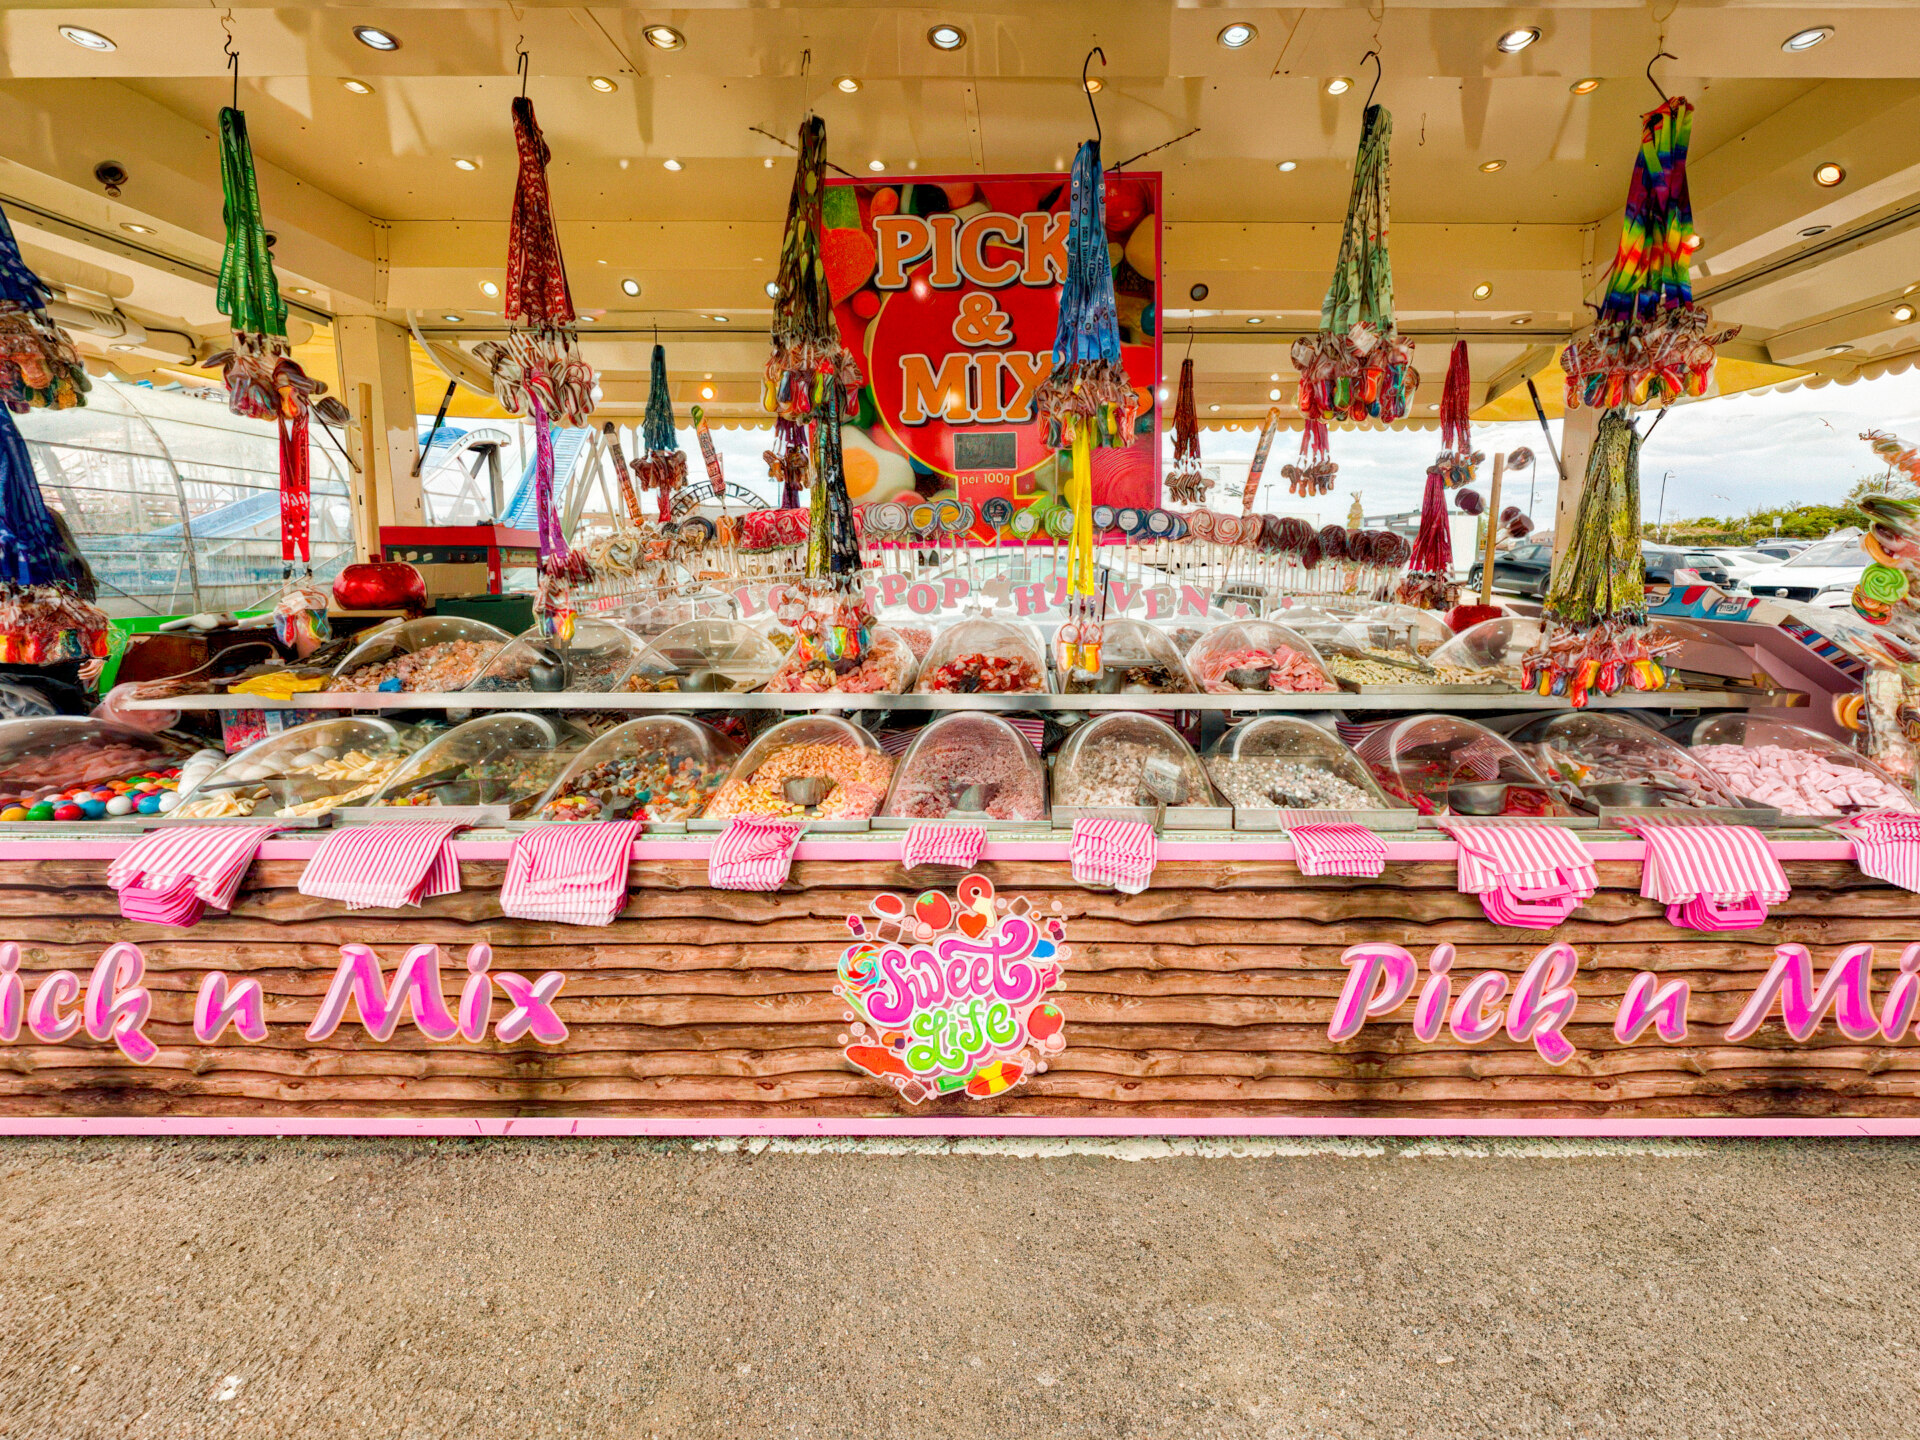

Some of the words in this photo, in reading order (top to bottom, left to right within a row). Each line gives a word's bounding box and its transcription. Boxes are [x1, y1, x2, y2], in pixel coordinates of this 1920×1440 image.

[872, 213, 1071, 288] PICK
[952, 291, 1013, 346] &
[899, 351, 1064, 424] MIX
[734, 573, 970, 618] LOIPOP
[0, 941, 160, 1065] ick
[193, 970, 269, 1043] n
[305, 942, 569, 1044] Mix
[864, 914, 1039, 1025] Sweet
[1327, 942, 1579, 1066] Pick
[1614, 971, 1691, 1043] n
[1724, 942, 1920, 1044] Mi
[905, 998, 1018, 1073] Life
